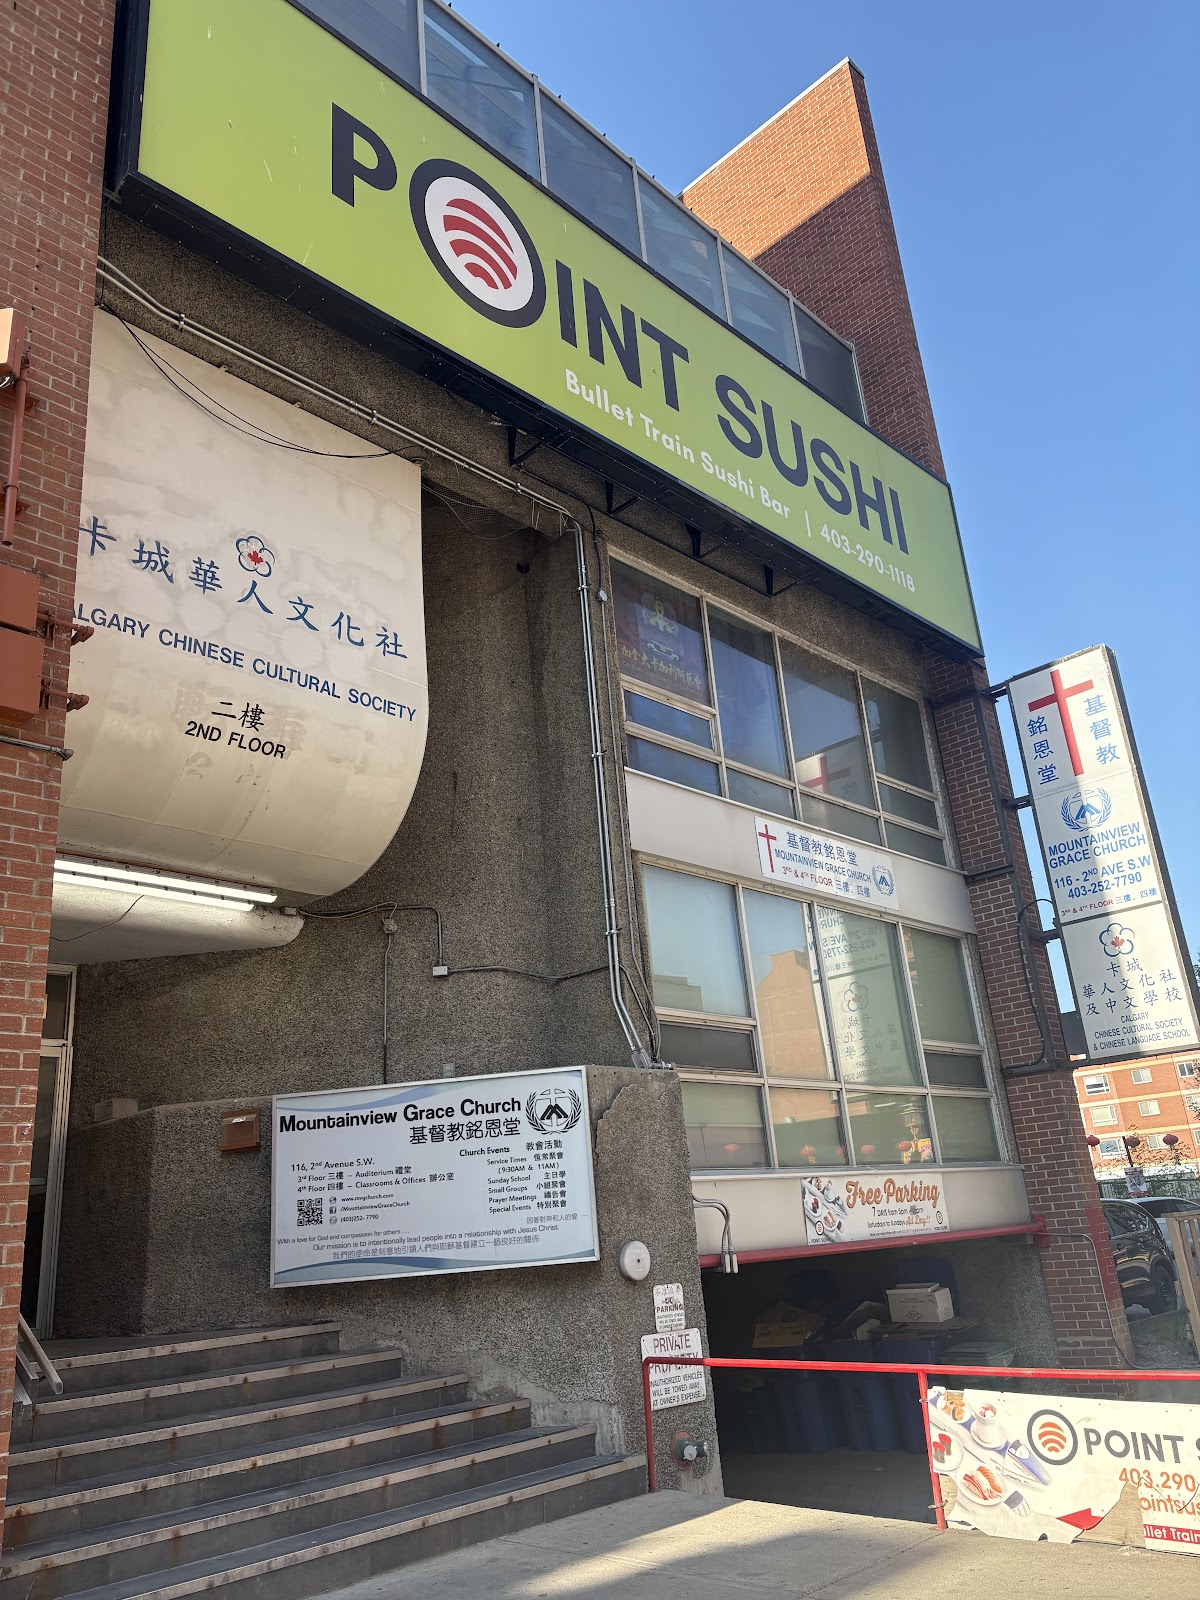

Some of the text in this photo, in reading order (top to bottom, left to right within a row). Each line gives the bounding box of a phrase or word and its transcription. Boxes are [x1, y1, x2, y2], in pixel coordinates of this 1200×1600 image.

[332, 102, 910, 556] POINT SUSHI
[565, 368, 634, 428] Bullet
[639, 412, 695, 465] Train
[701, 450, 756, 500] Sushi
[760, 484, 791, 520] Bar
[819, 522, 916, 594] 403-290-1118
[79, 516, 408, 660] 卡城華人文化社
[72, 602, 417, 722] LGARY CHINESE CULTURAL SOCIETY
[211, 700, 266, 733] 二樓
[184, 720, 287, 760] 2ND FLOOR
[1083, 692, 1122, 766] 基督教
[1027, 715, 1060, 786] 銘恩堂
[786, 831, 859, 867] 基督教銘恩堂
[1048, 822, 1141, 857] MOUNTAINVIEW
[1049, 833, 1147, 869] GRACE CHURCH
[774, 848, 872, 883] MOUNTAINVIEW GRACE CHURCH
[782, 866, 793, 875] 3RD
[794, 869, 800, 878] &
[810, 873, 833, 887] FLOOR
[1054, 855, 1151, 889] 116 2ND AVE S.W
[1068, 871, 1143, 899] 403-252-7790
[1090, 899, 1114, 909] FLOOR
[1106, 957, 1144, 978] 卡城
[1082, 968, 1177, 1000] 華人文化社
[1085, 986, 1184, 1017] 及中文學校
[1094, 1017, 1184, 1040] CHINESE CULTURAL SOCIETY
[1120, 1011, 1150, 1024] CALGARY
[1093, 1028, 1191, 1051] & CHINESE LANGUAGE SCHOOL
[279, 1097, 522, 1133] Mountainview Grace Church
[409, 1117, 521, 1145] 基督教銘恩堂
[459, 1139, 563, 1157] Church Events 教會活動
[291, 1157, 375, 1172] 116, 2nd Avenue S.W.
[297, 1175, 307, 1183] 3rd
[355, 1169, 394, 1178] Auditorium
[297, 1185, 307, 1193] 4th
[355, 1180, 393, 1189] Classrooms
[401, 1177, 426, 1185] Offices
[487, 1177, 510, 1185] Sunday
[510, 1175, 531, 1183] School
[505, 1185, 528, 1194] Groups
[488, 1197, 508, 1205] Prayer
[508, 1195, 537, 1203] Meetings
[845, 1177, 941, 1209] Free Parking
[488, 1206, 511, 1214] Special
[511, 1204, 532, 1212] Events
[887, 1208, 898, 1216] from
[867, 1221, 886, 1229] Saturdays
[890, 1219, 906, 1227] Sundays
[276, 1237, 291, 1245] With
[340, 1232, 374, 1241] compassion
[313, 1243, 326, 1251] Our
[326, 1242, 352, 1250] mission
[367, 1238, 406, 1247] intentionally
[406, 1236, 421, 1244] lead
[422, 1232, 444, 1243] people
[444, 1231, 457, 1240] into
[464, 1229, 502, 1239] relationship
[502, 1227, 517, 1235] with
[517, 1226, 538, 1234] Jesus
[538, 1224, 559, 1232] Christ
[656, 1303, 684, 1314] PARKING
[652, 1333, 692, 1354] PRIVATE
[650, 1370, 703, 1388] NAUTHORIZED VEHICLES
[651, 1381, 700, 1397] WILL BE TOWED AWAY
[652, 1398, 658, 1407] AT
[680, 1391, 702, 1402] EXPENSE
[1083, 1427, 1184, 1464] POINT
[1118, 1467, 1196, 1493] 403.290
